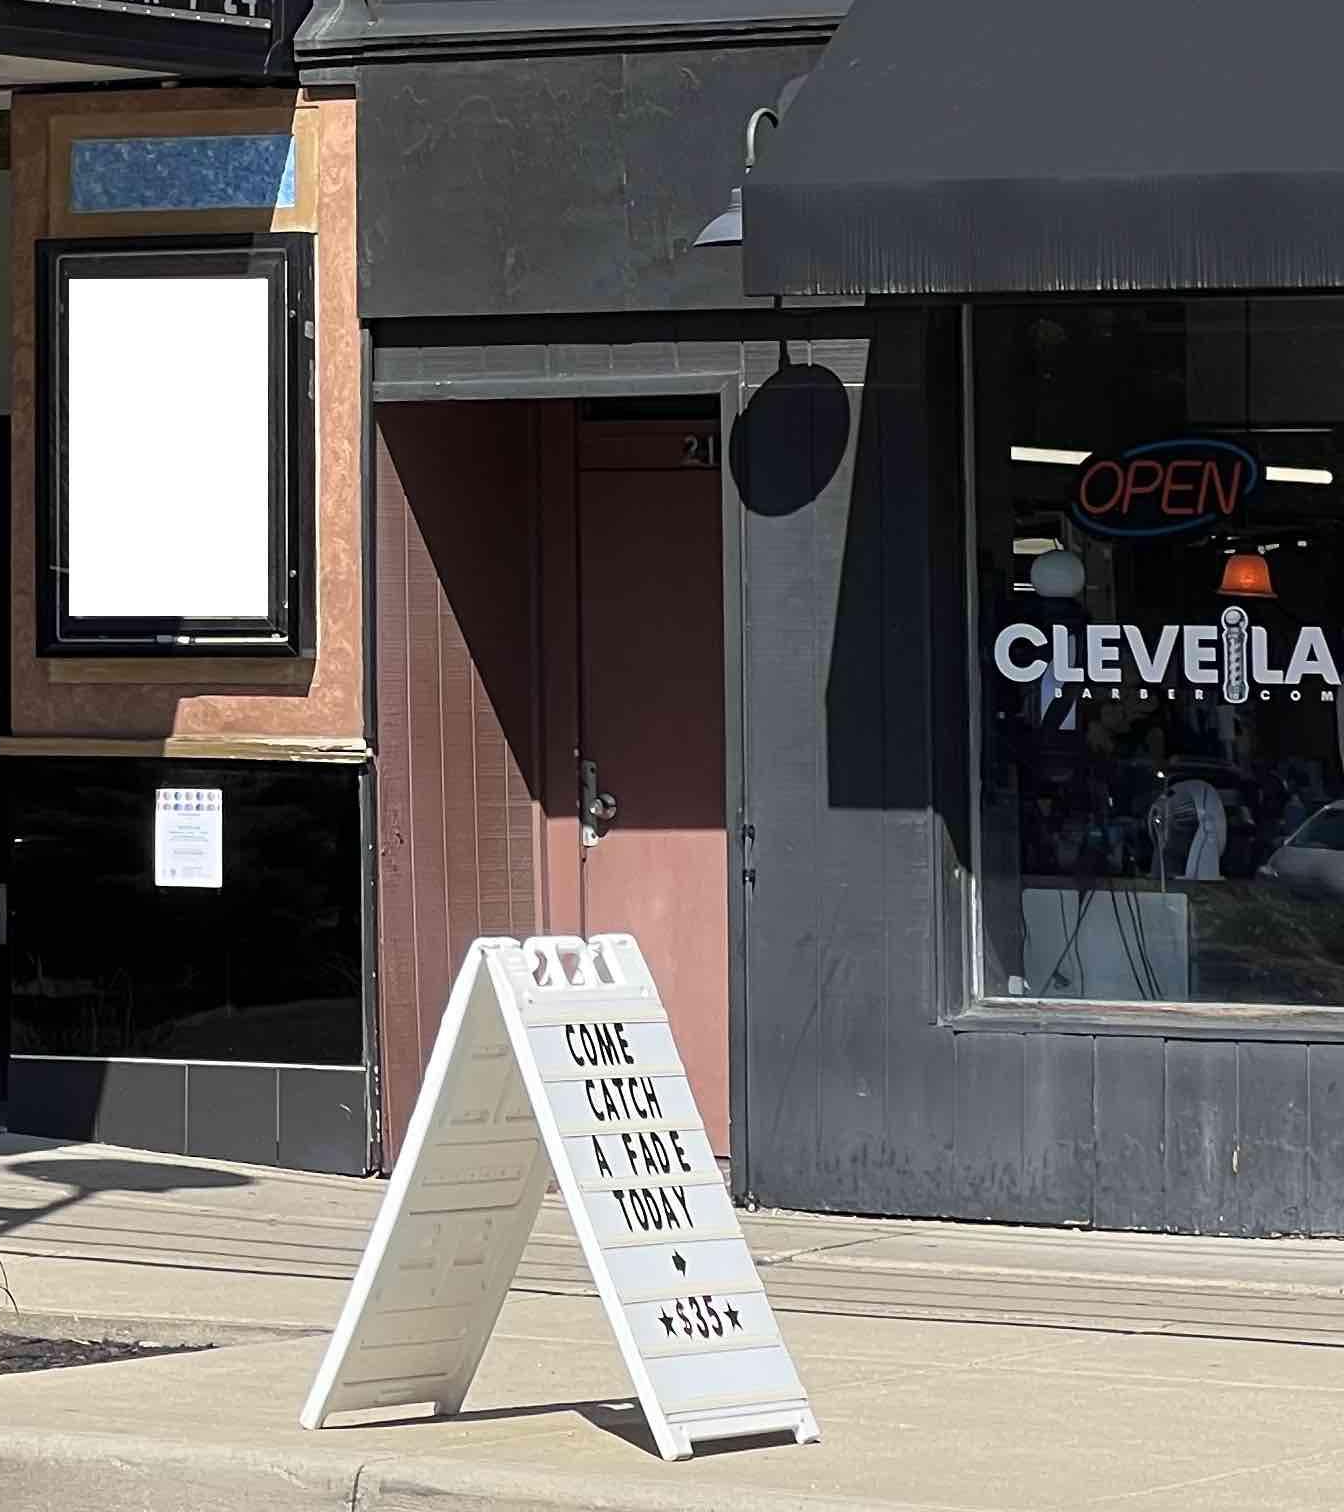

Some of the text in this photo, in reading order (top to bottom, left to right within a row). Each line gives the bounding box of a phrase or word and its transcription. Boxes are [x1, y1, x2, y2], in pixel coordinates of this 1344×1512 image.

[1080, 460, 1242, 515] OPEN
[1054, 688, 1205, 701] BARBER
[566, 1023, 634, 1067] COME
[585, 1077, 662, 1122] CATCH
[592, 1130, 691, 1177] A FADE
[613, 1187, 694, 1232] TODAY
